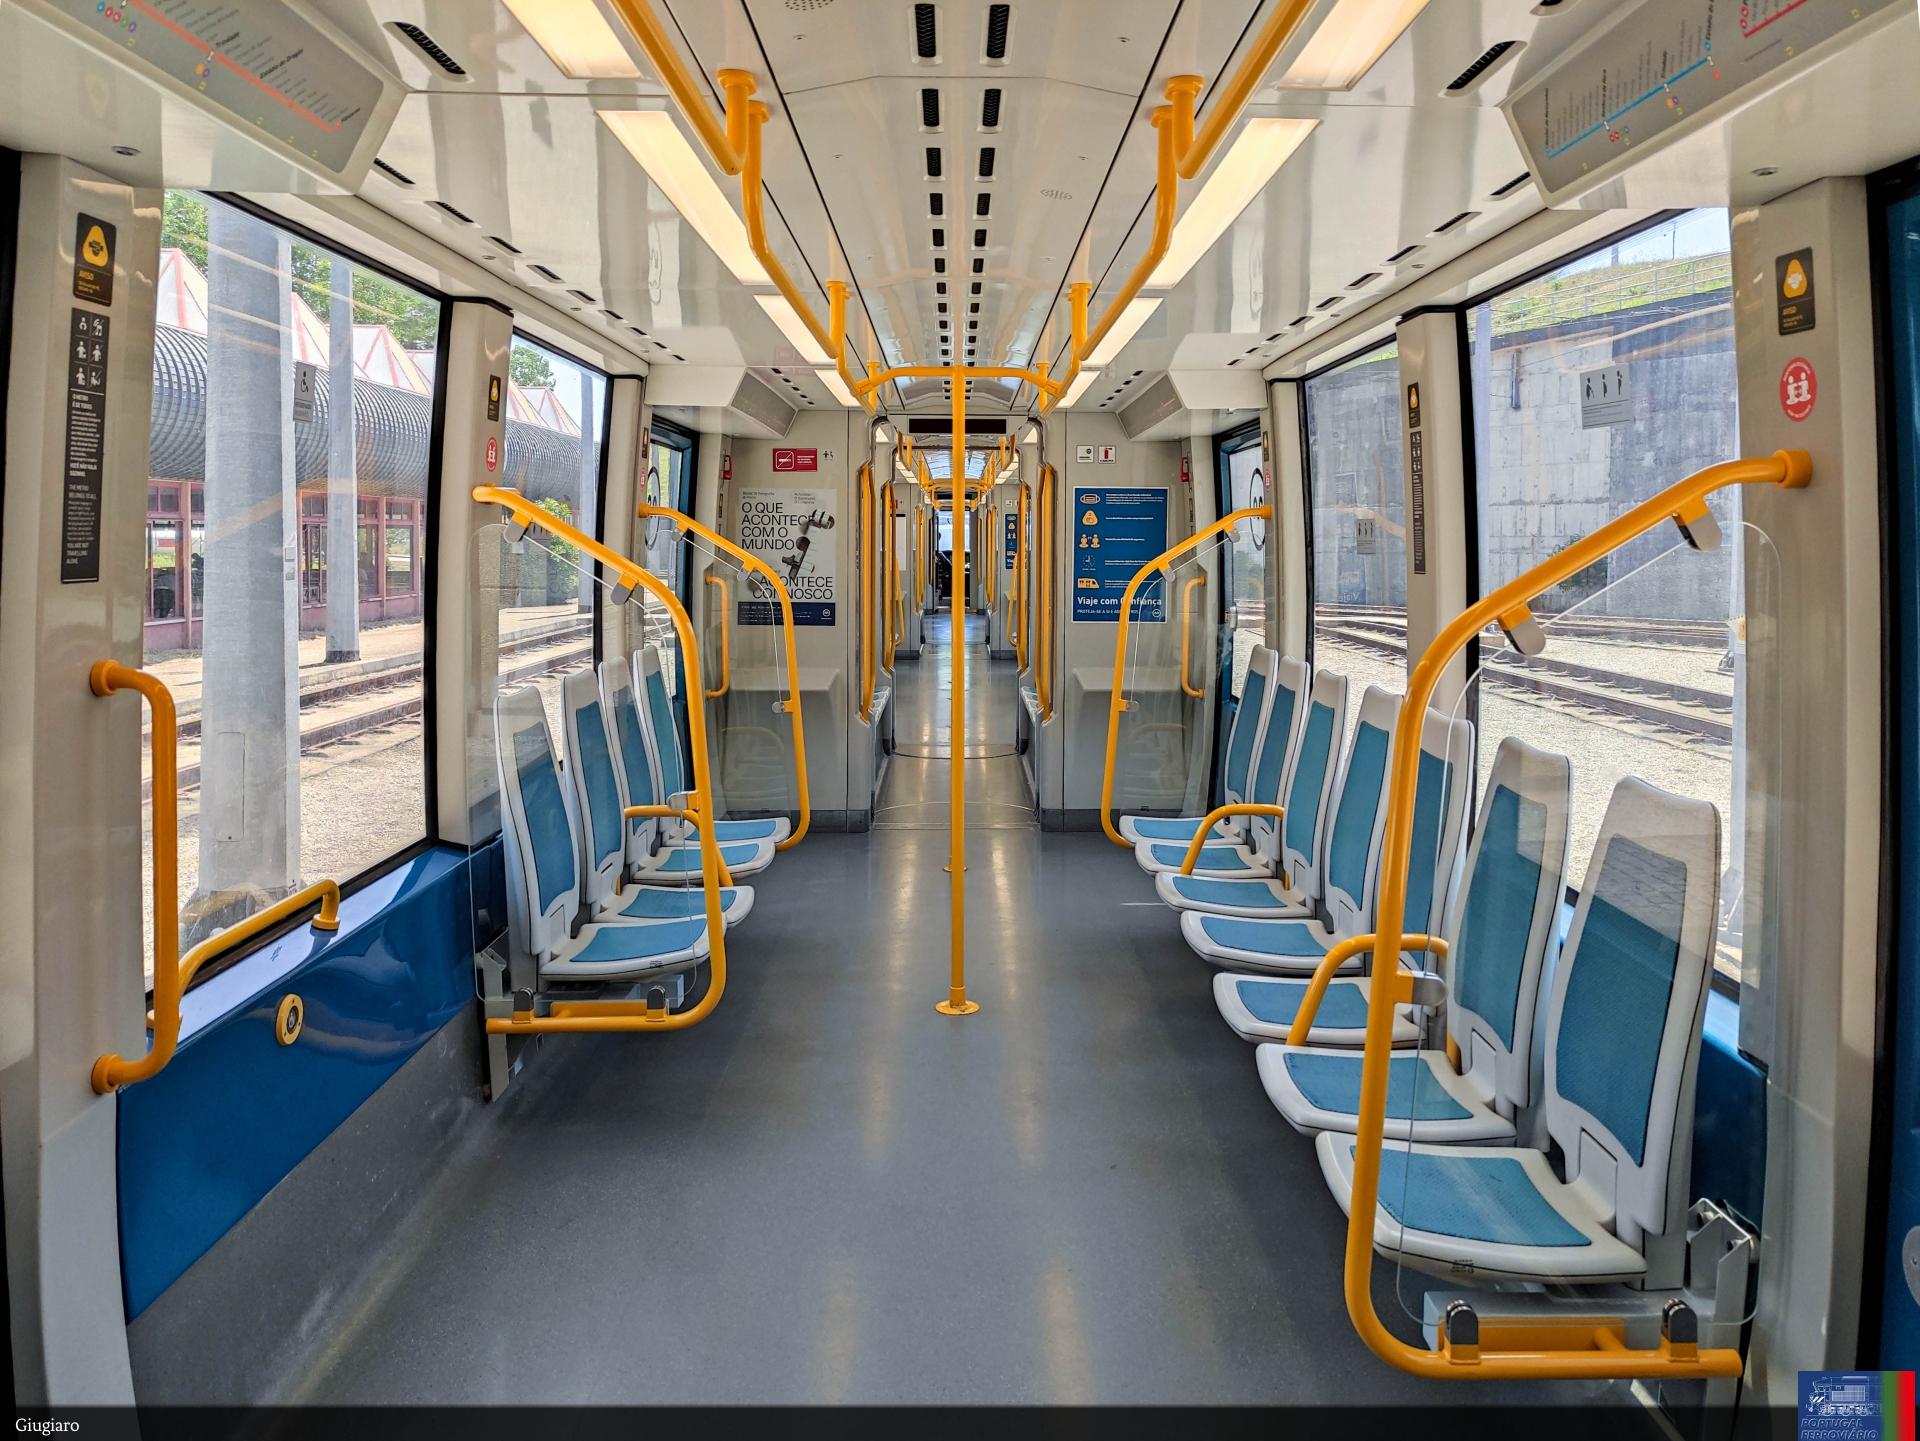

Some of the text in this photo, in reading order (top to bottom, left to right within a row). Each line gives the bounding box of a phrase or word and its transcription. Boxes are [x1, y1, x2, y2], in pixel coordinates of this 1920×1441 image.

[741, 502, 783, 514] O QUE
[741, 526, 788, 538] COM O
[741, 538, 795, 550] MUNDO
[760, 576, 833, 588] AONTECE
[1077, 596, 1099, 607] Viaje
